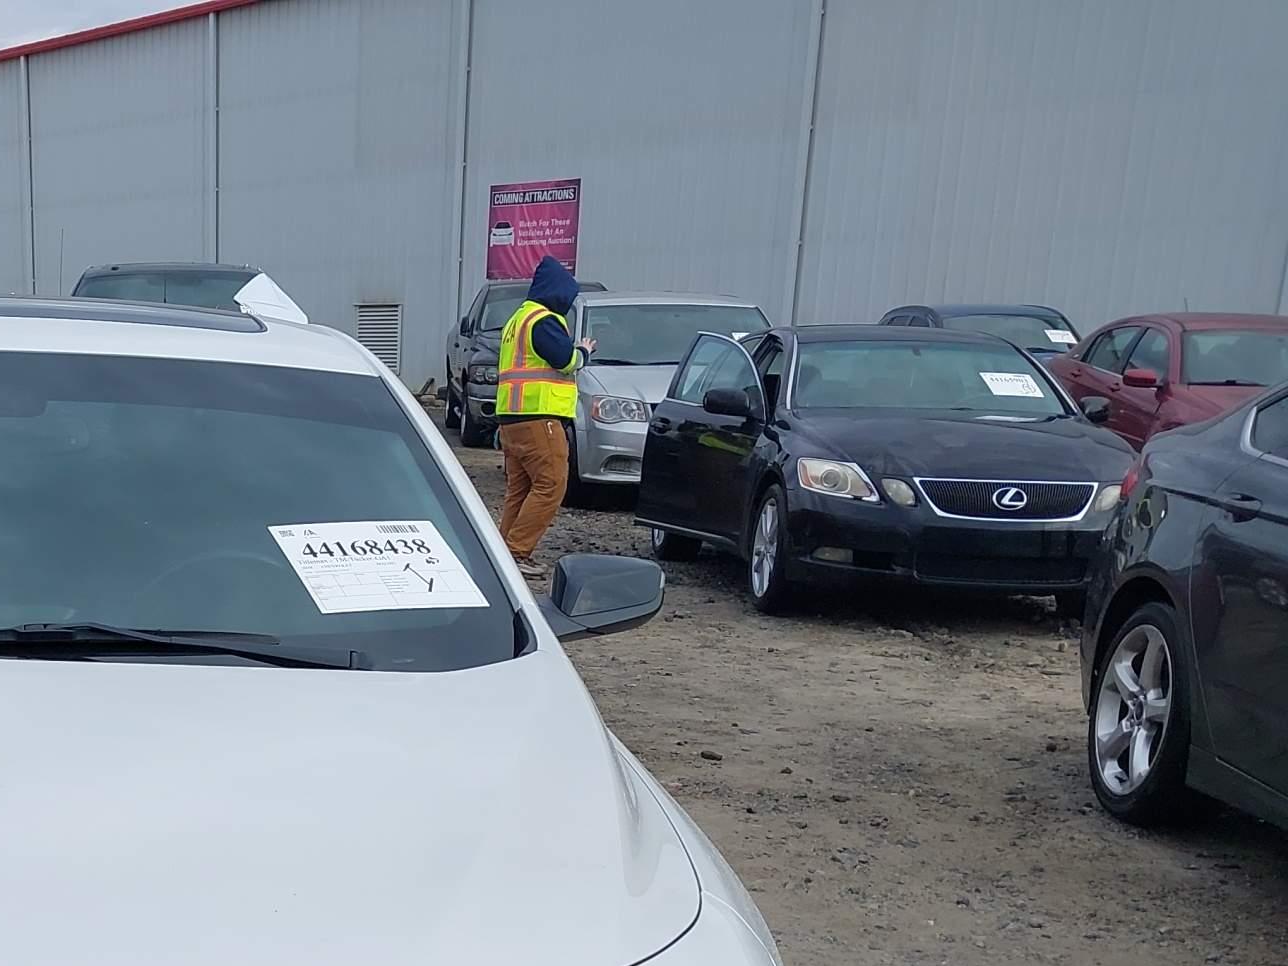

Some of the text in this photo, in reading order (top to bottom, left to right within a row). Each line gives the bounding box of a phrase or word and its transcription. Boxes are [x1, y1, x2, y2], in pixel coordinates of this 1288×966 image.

[494, 188, 575, 205] COMING ATTRACTIONS
[551, 218, 571, 226] These
[302, 539, 431, 558] 44168438
